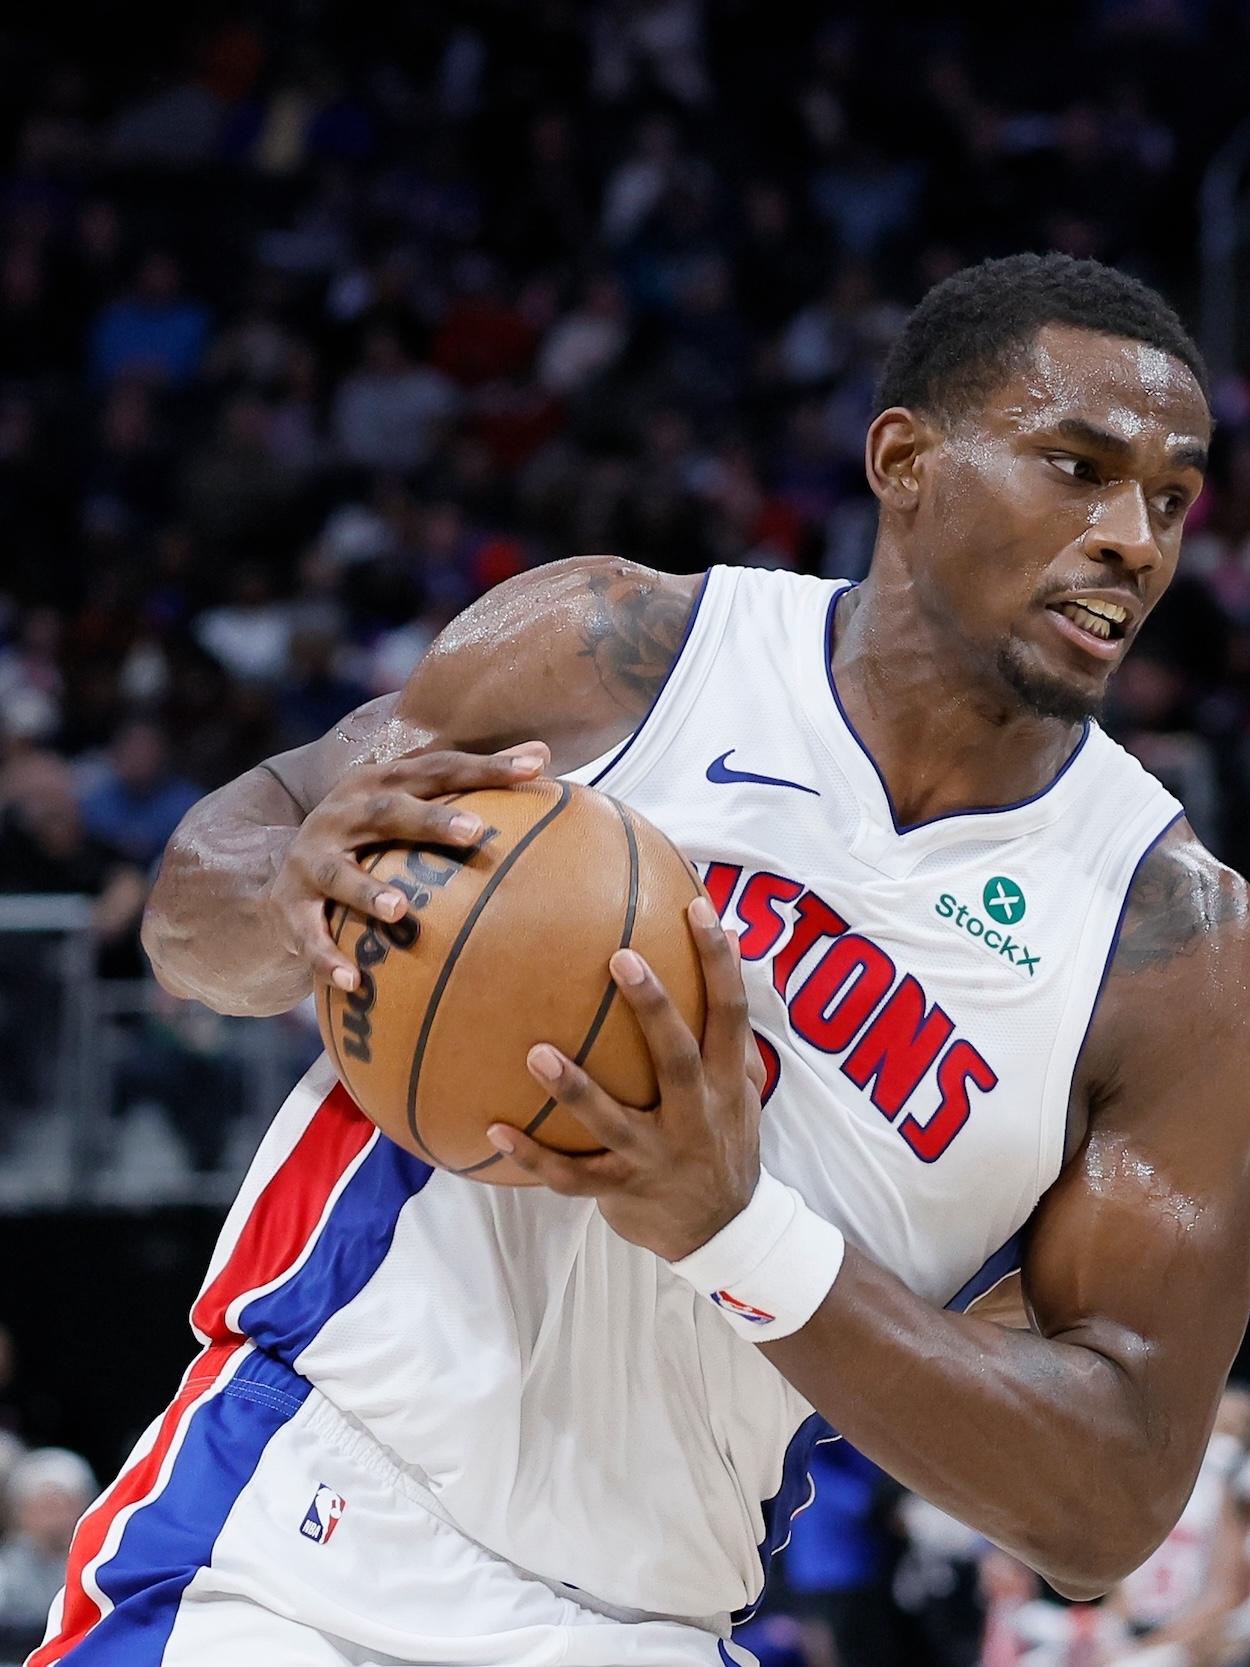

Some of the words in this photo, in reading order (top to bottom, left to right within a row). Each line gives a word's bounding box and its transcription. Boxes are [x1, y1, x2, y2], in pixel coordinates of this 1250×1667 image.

[935, 893, 1042, 978] StockX
[690, 861, 999, 1164] ISTONS
[301, 1519, 322, 1539] NBA
